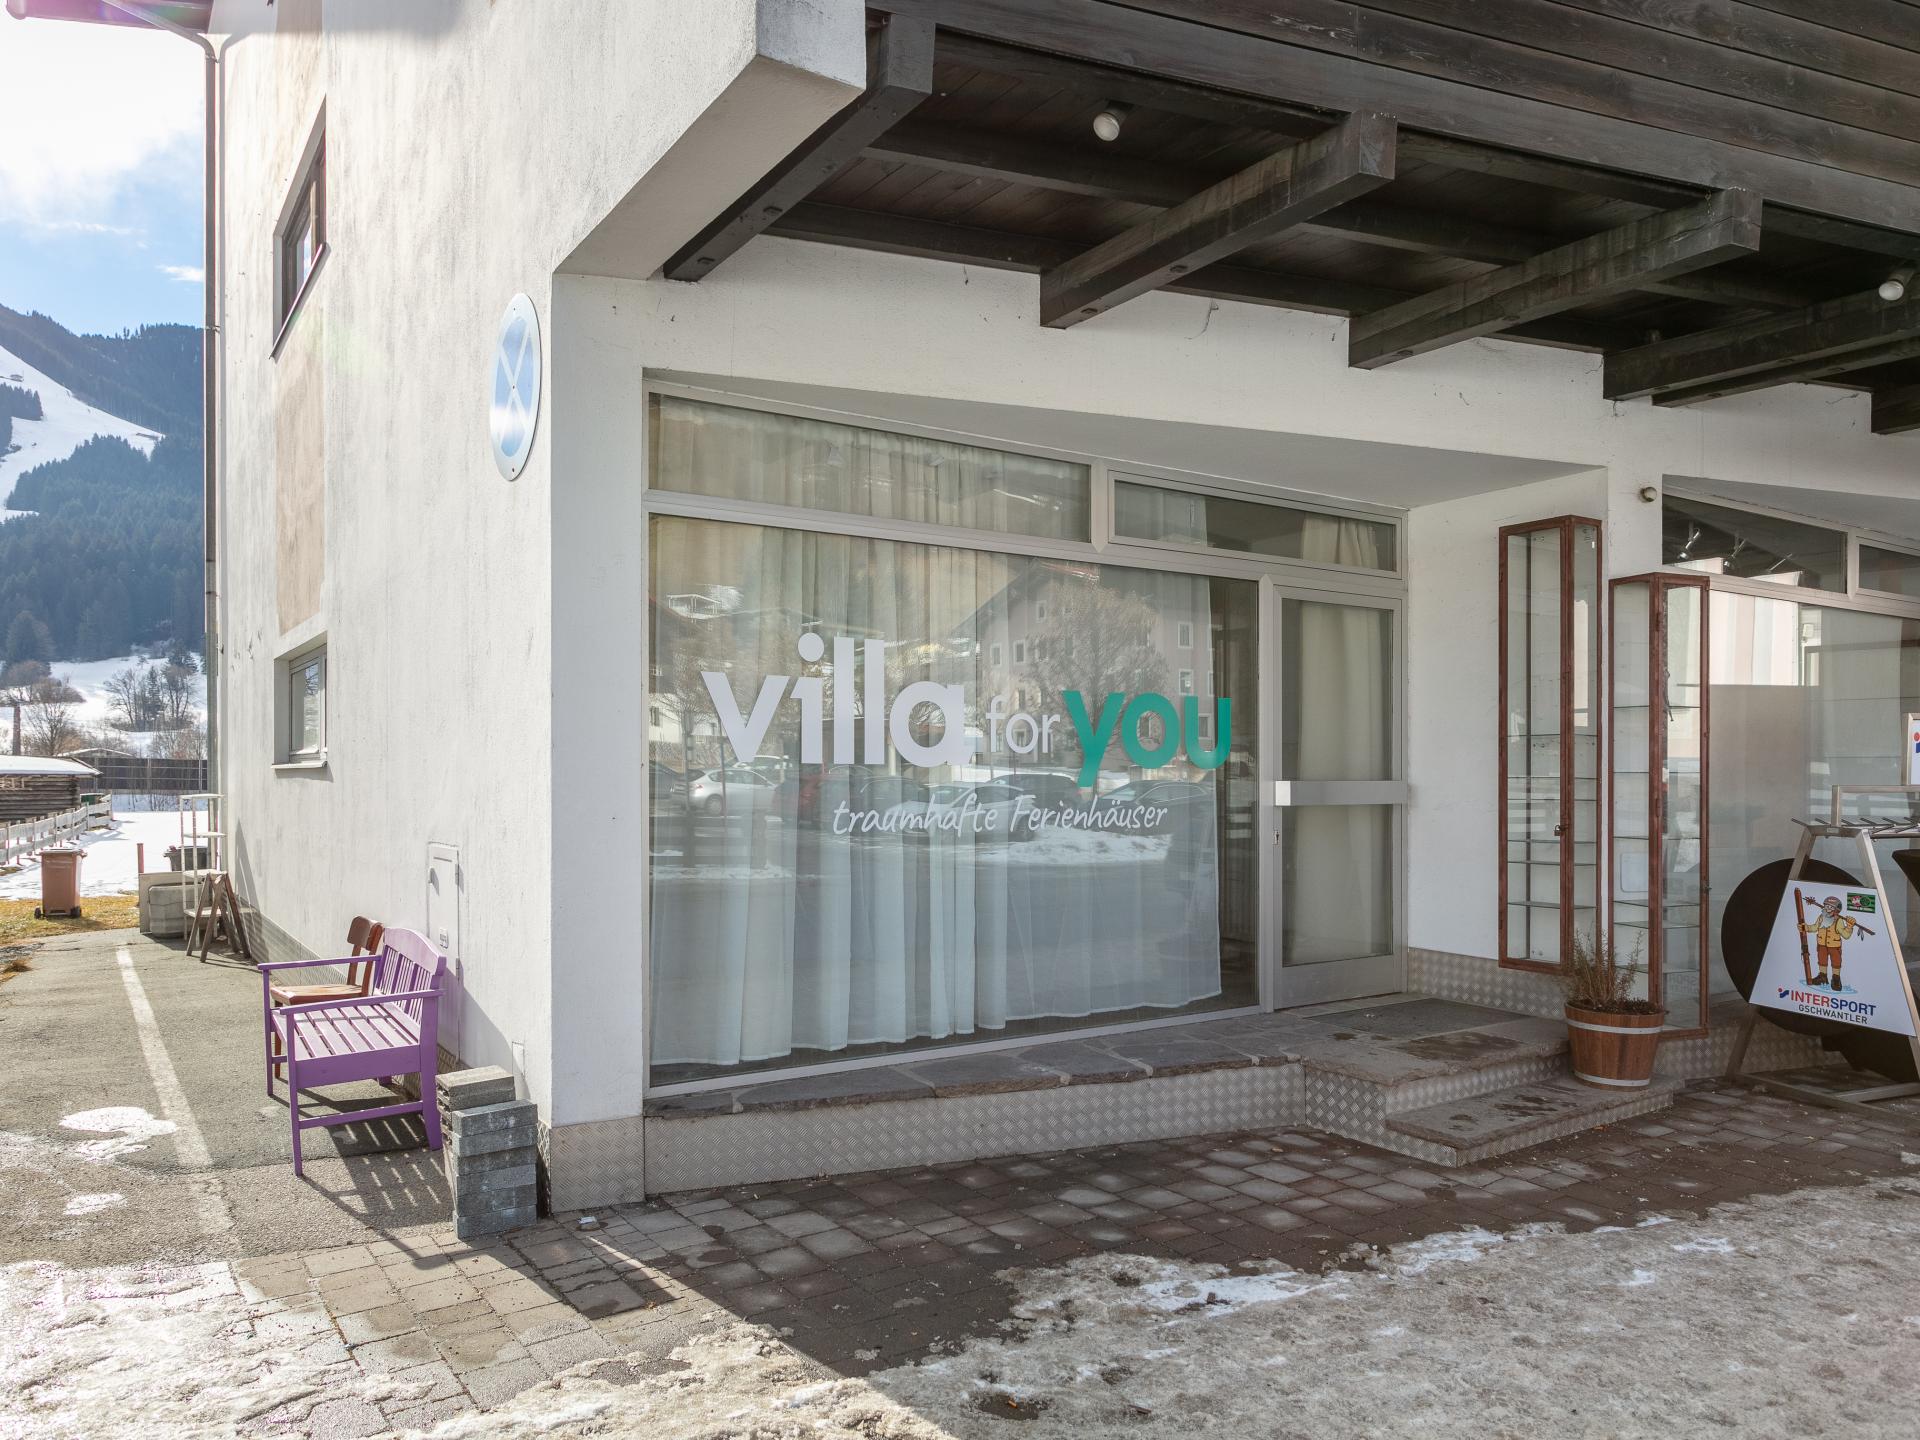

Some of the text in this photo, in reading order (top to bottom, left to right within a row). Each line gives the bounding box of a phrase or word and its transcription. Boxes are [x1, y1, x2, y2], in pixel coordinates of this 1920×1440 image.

[701, 632, 1233, 788] villa for you
[833, 792, 1168, 837] traumhafte Ferienhäuser
[1791, 990, 1876, 1016] INTERSPORT
[1798, 1004, 1868, 1025] GSCHWANTLER
